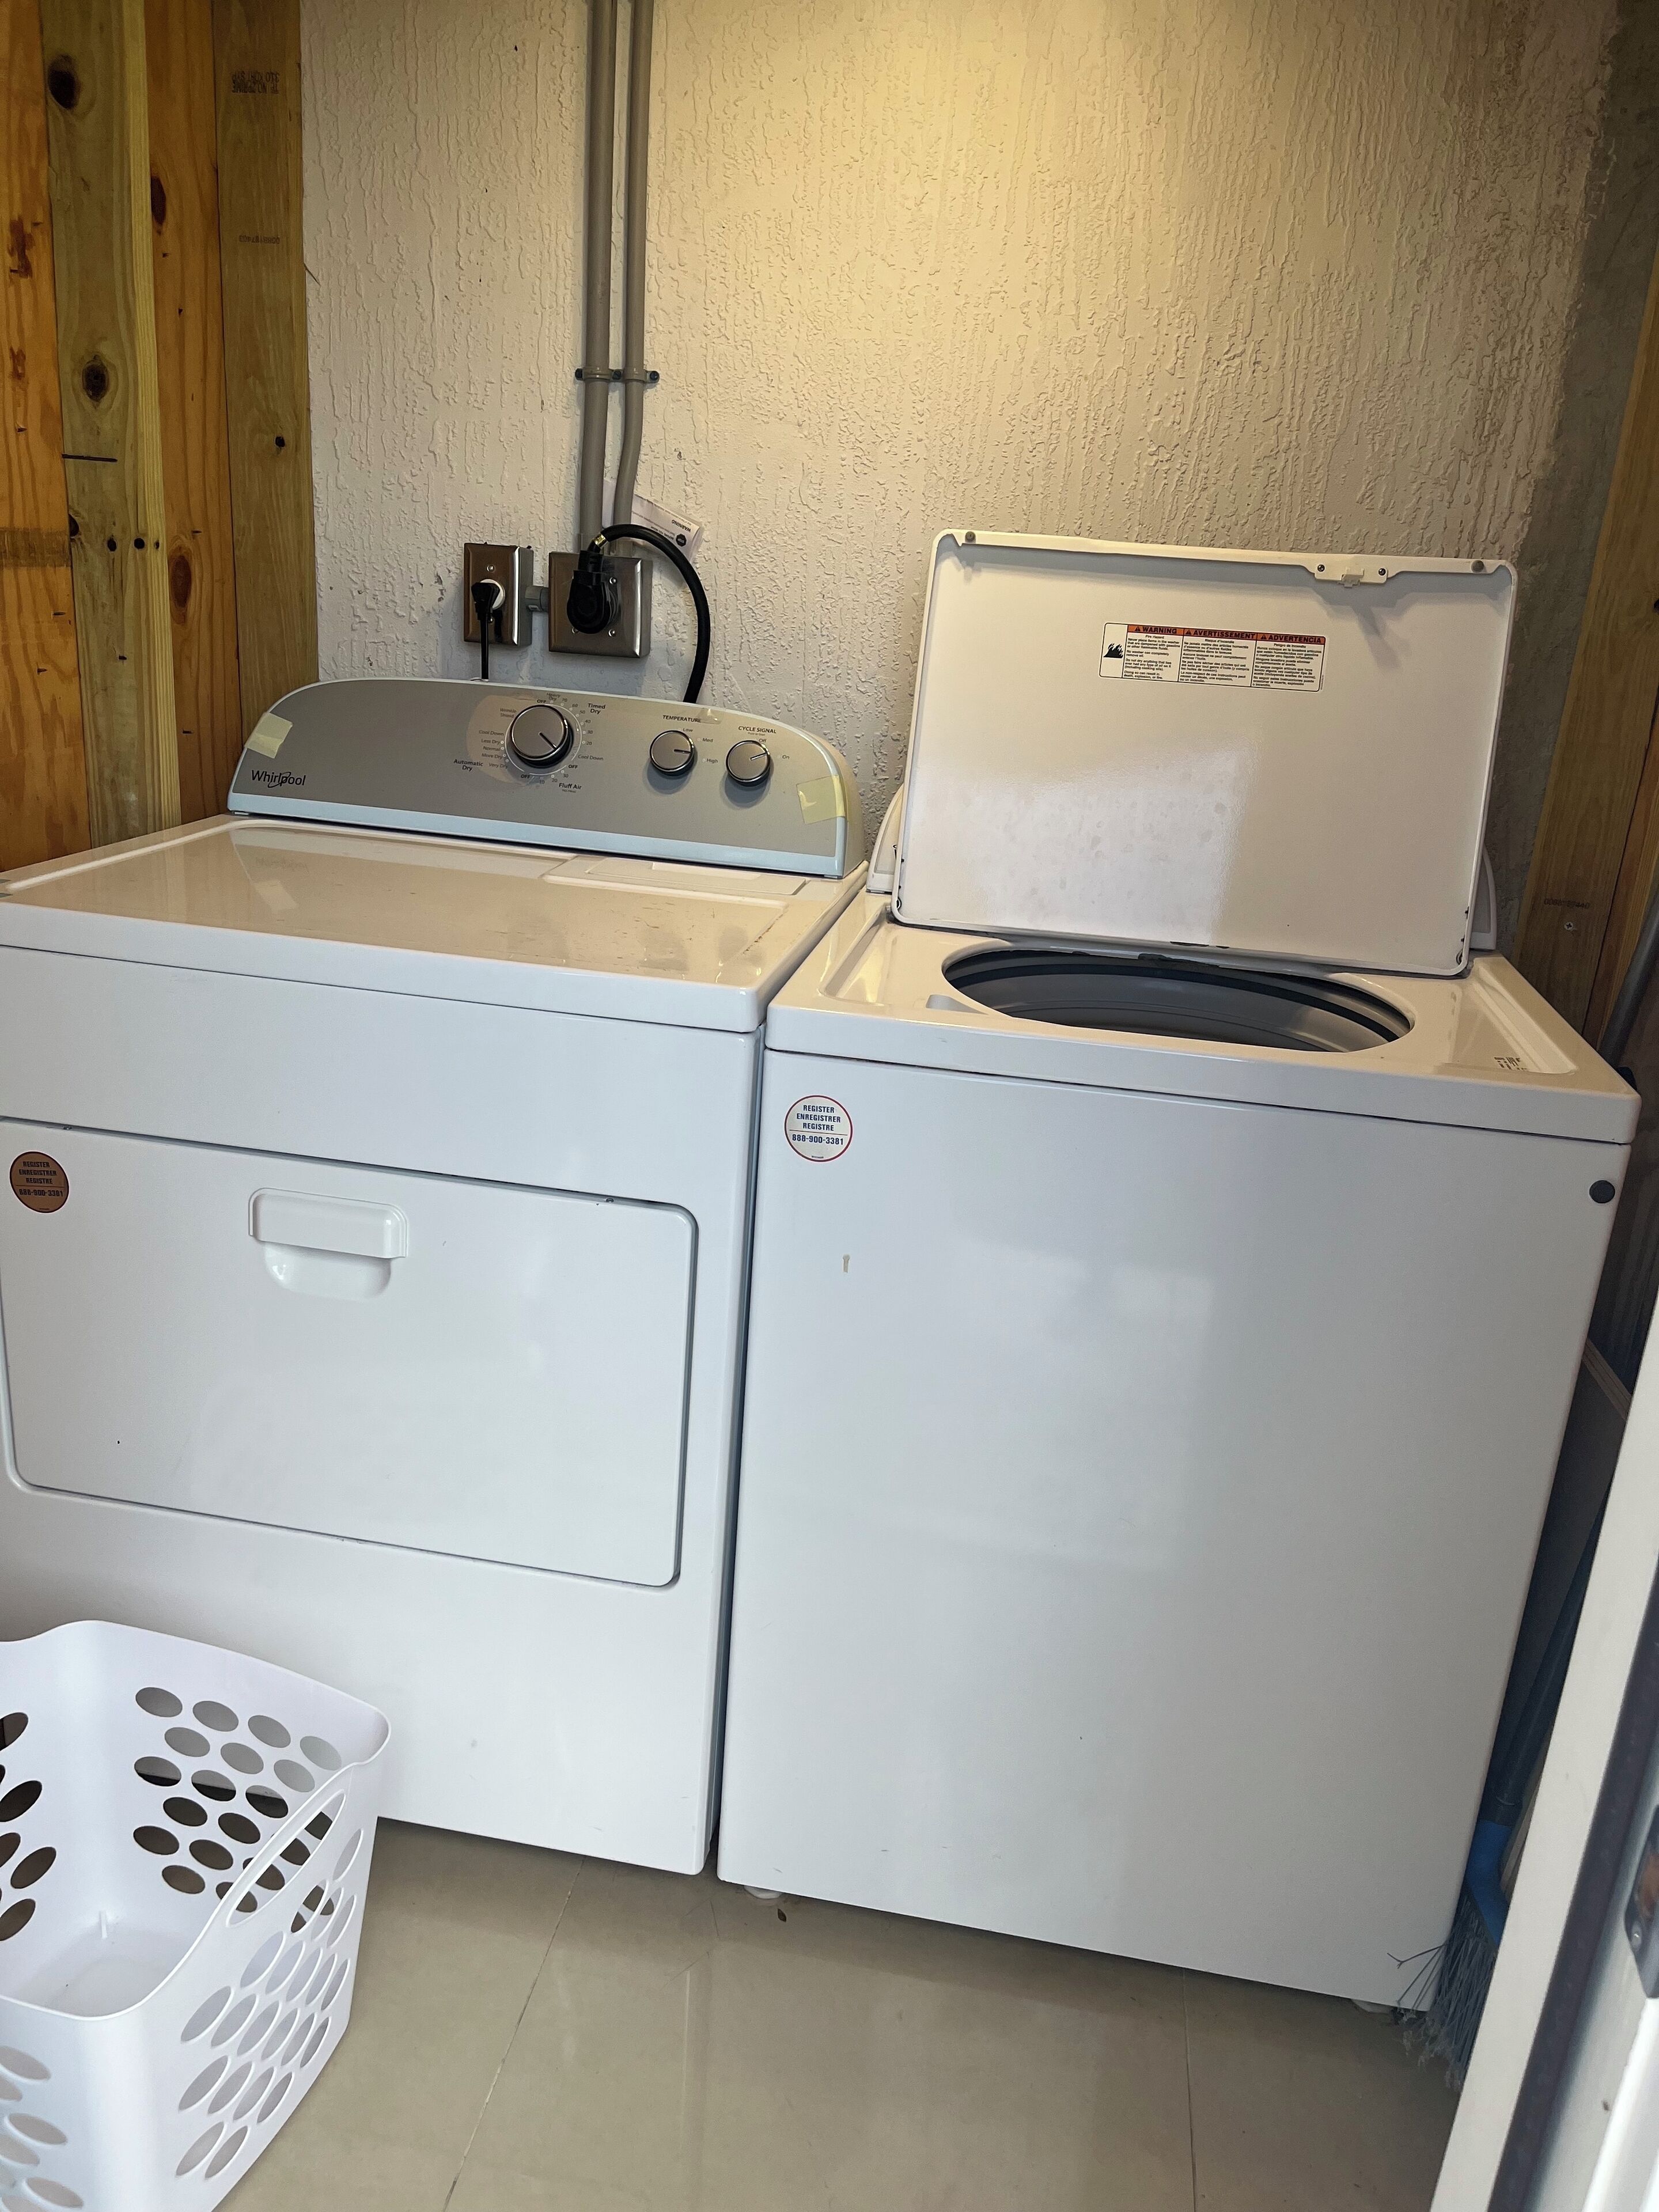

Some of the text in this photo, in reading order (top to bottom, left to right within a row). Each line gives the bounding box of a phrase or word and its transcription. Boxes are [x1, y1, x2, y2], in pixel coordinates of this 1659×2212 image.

[1142, 626, 1177, 635] WARNING
[1193, 629, 1256, 640] AVERTISSEMENT
[1268, 634, 1321, 644] ADVERTENCIA
[662, 715, 702, 723] TEMPERATURE
[453, 759, 484, 767] Automatic
[251, 770, 306, 788] Whirlpool
[803, 1105, 835, 1113] REGISTER
[797, 1113, 841, 1123] ENREGISTRER
[802, 1123, 834, 1131] REGISTRE
[792, 1134, 844, 1145] 888-900-3381
[19, 1189, 63, 1197] 888-900-3381
